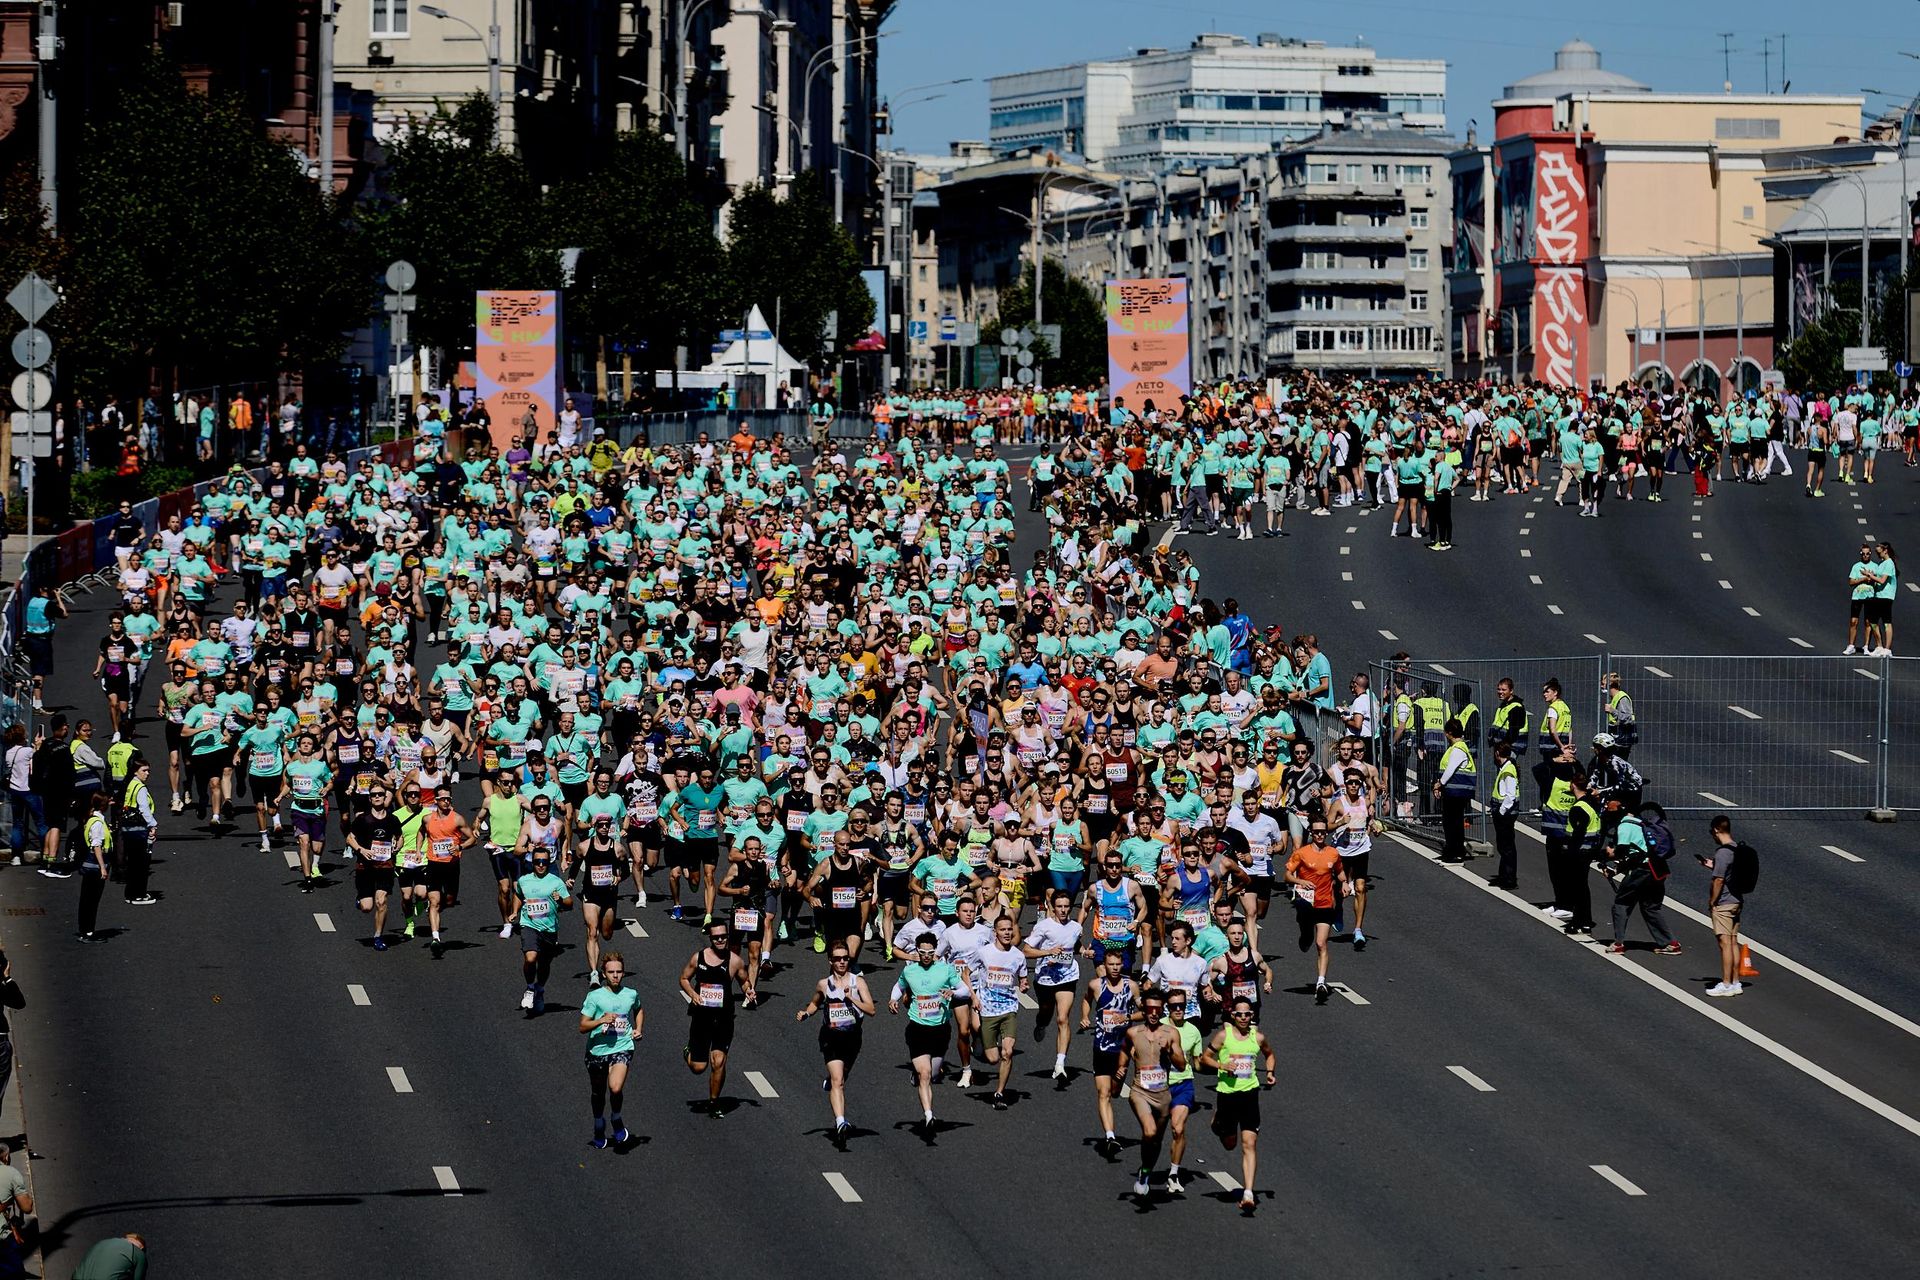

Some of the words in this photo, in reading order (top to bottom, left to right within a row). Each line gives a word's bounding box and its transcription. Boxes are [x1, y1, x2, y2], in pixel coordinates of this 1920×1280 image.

[1136, 381, 1164, 389] ЛЕТО
[502, 392, 530, 400] ЛЕТО
[1106, 768, 1127, 776] 50510
[787, 816, 804, 825] 5401
[833, 892, 855, 900] 51564
[527, 903, 548, 912] 51161
[1105, 920, 1126, 929] 50274
[988, 973, 1010, 982] 51973
[701, 989, 723, 999] 52898
